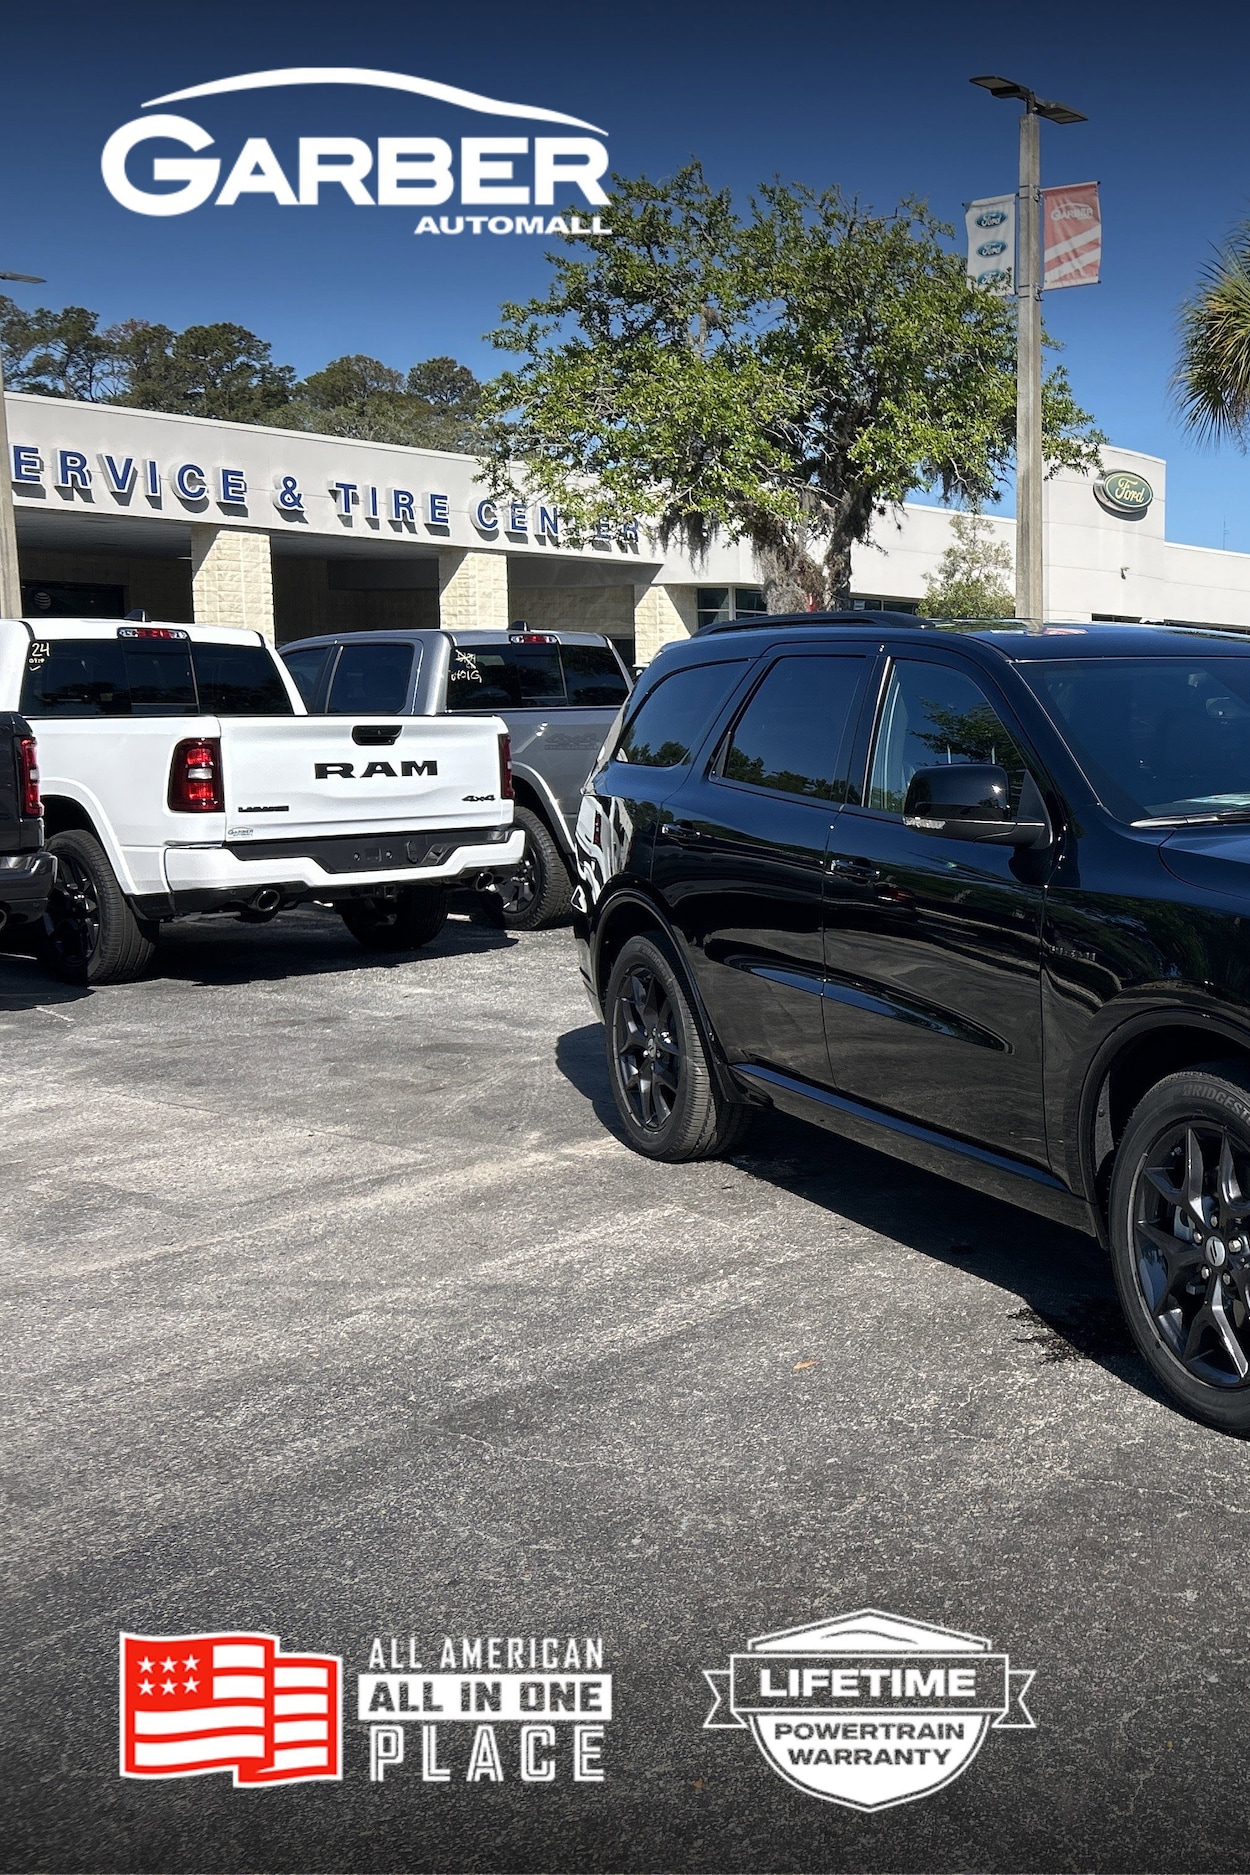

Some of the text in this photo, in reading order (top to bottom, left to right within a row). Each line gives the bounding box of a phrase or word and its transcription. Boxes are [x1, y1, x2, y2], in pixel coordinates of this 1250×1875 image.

[981, 213, 1002, 227] Ford
[1051, 206, 1094, 221] GARBER
[982, 242, 1003, 256] Ford
[10, 443, 640, 543] ERVICE & TIRE CENER
[1115, 477, 1146, 503] Ford
[31, 642, 51, 657] 24
[315, 760, 438, 779] RAM
